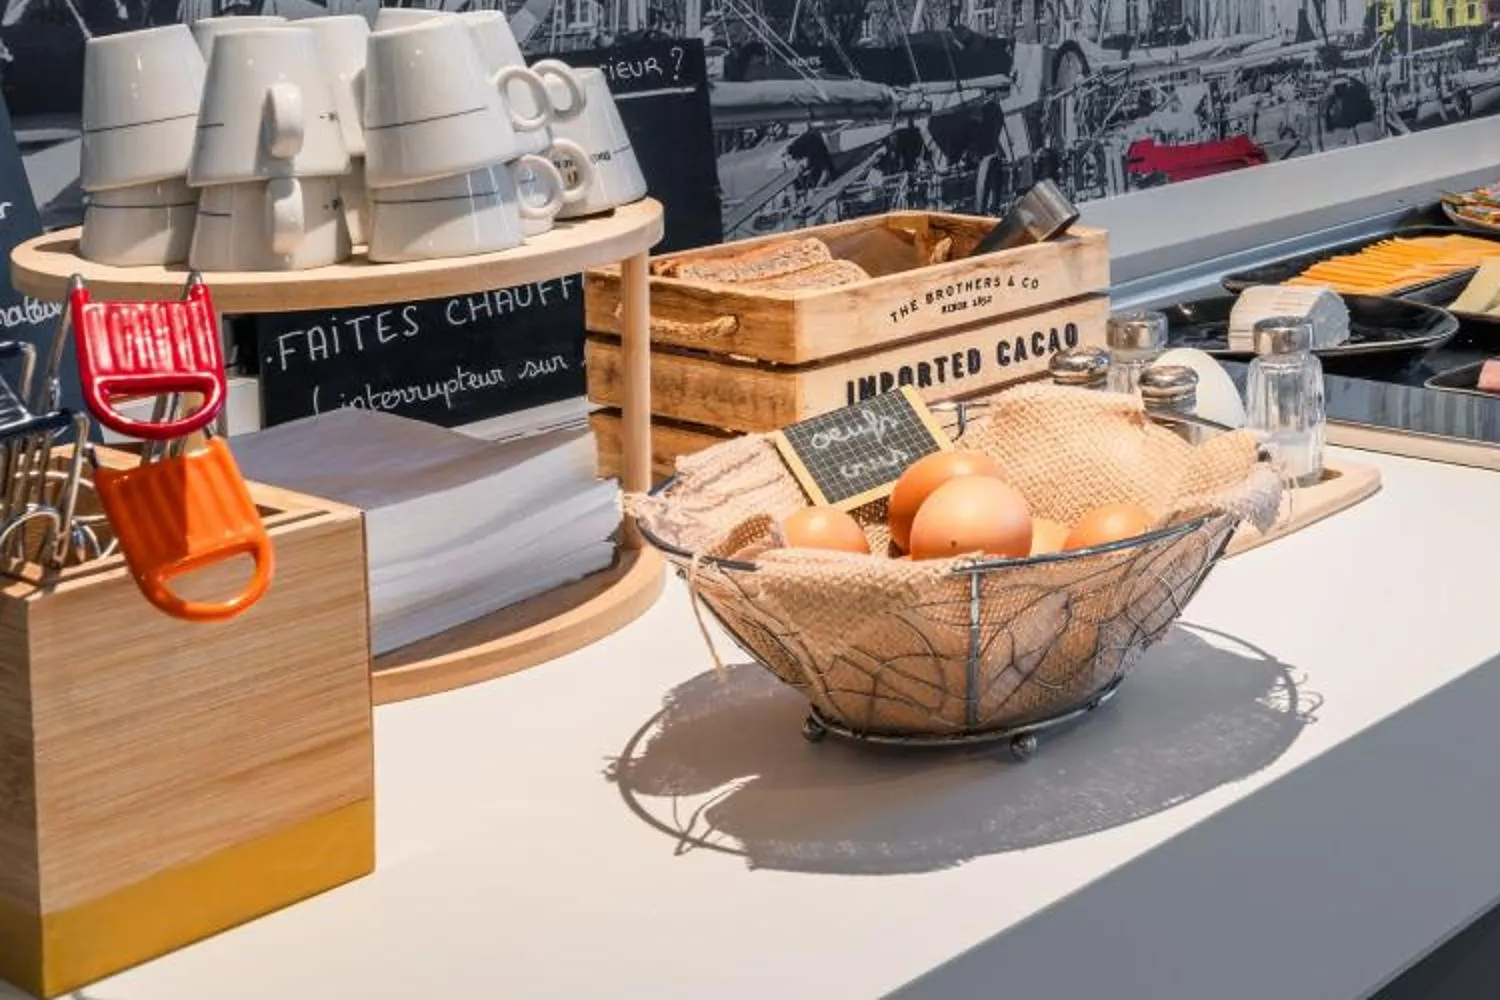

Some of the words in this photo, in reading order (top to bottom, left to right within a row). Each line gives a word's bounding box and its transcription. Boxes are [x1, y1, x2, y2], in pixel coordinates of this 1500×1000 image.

[670, 47, 684, 81] ?
[445, 273, 586, 325] CHAUFF
[889, 299, 919, 323] THE
[925, 276, 1001, 304] BROTHERS
[1021, 277, 1039, 289] CO
[518, 355, 568, 379] sur
[846, 348, 982, 406] IMPORTED
[996, 322, 1079, 366] CACAO
